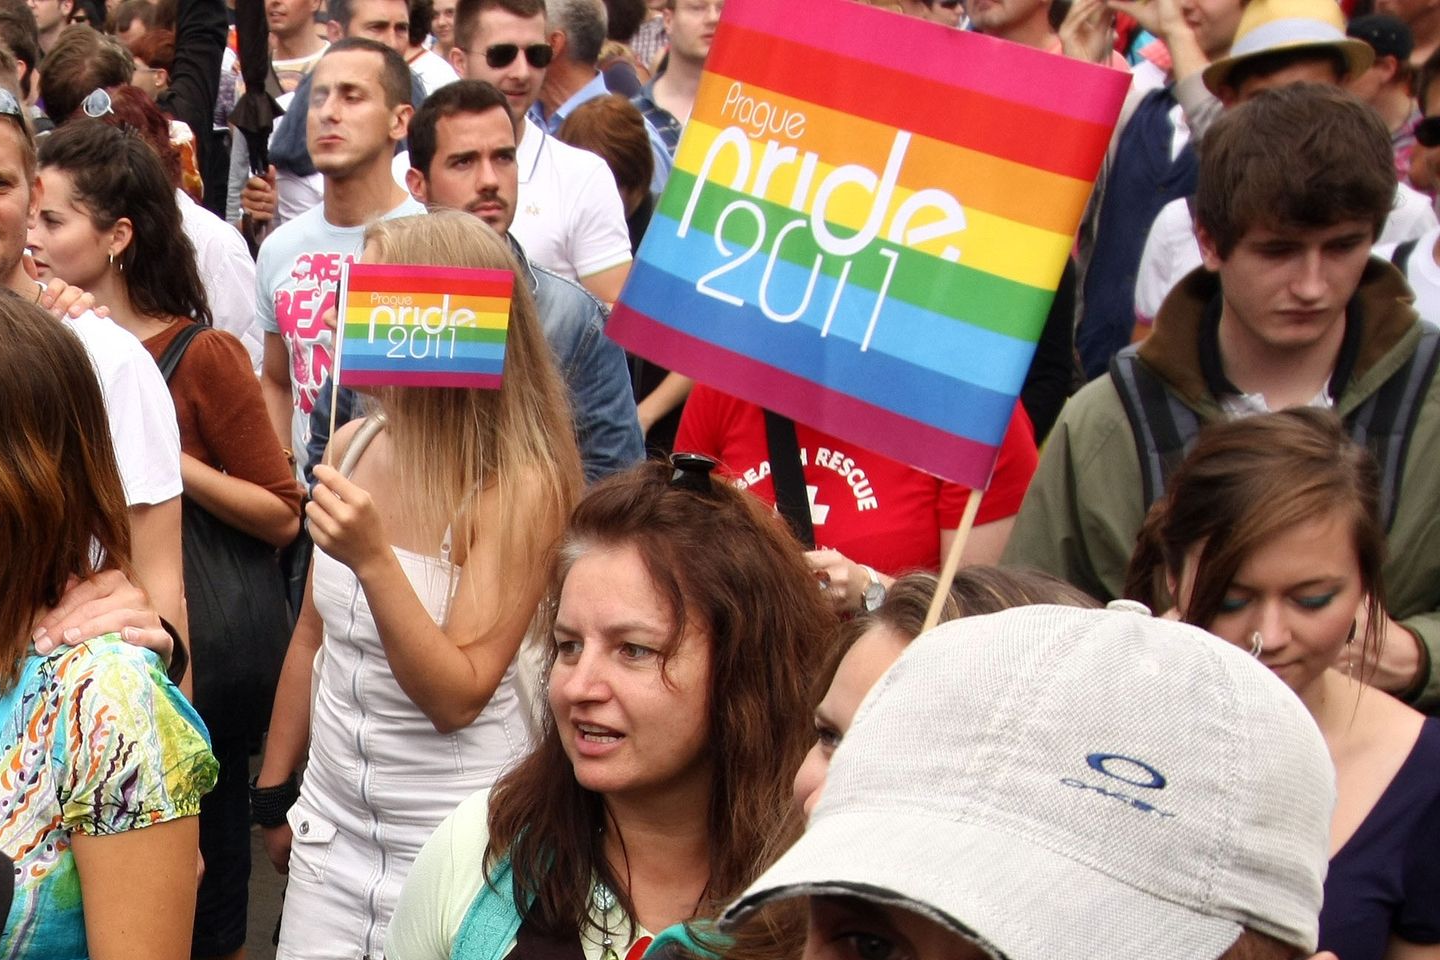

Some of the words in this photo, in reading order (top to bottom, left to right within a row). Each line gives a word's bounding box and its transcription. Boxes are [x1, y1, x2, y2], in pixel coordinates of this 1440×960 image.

[721, 81, 806, 139] Prague
[676, 126, 967, 262] pride
[370, 292, 413, 306] Prague
[696, 200, 899, 352] 2011
[368, 294, 477, 344] pride
[386, 326, 456, 359] 2011
[815, 447, 879, 512] RESCUE
